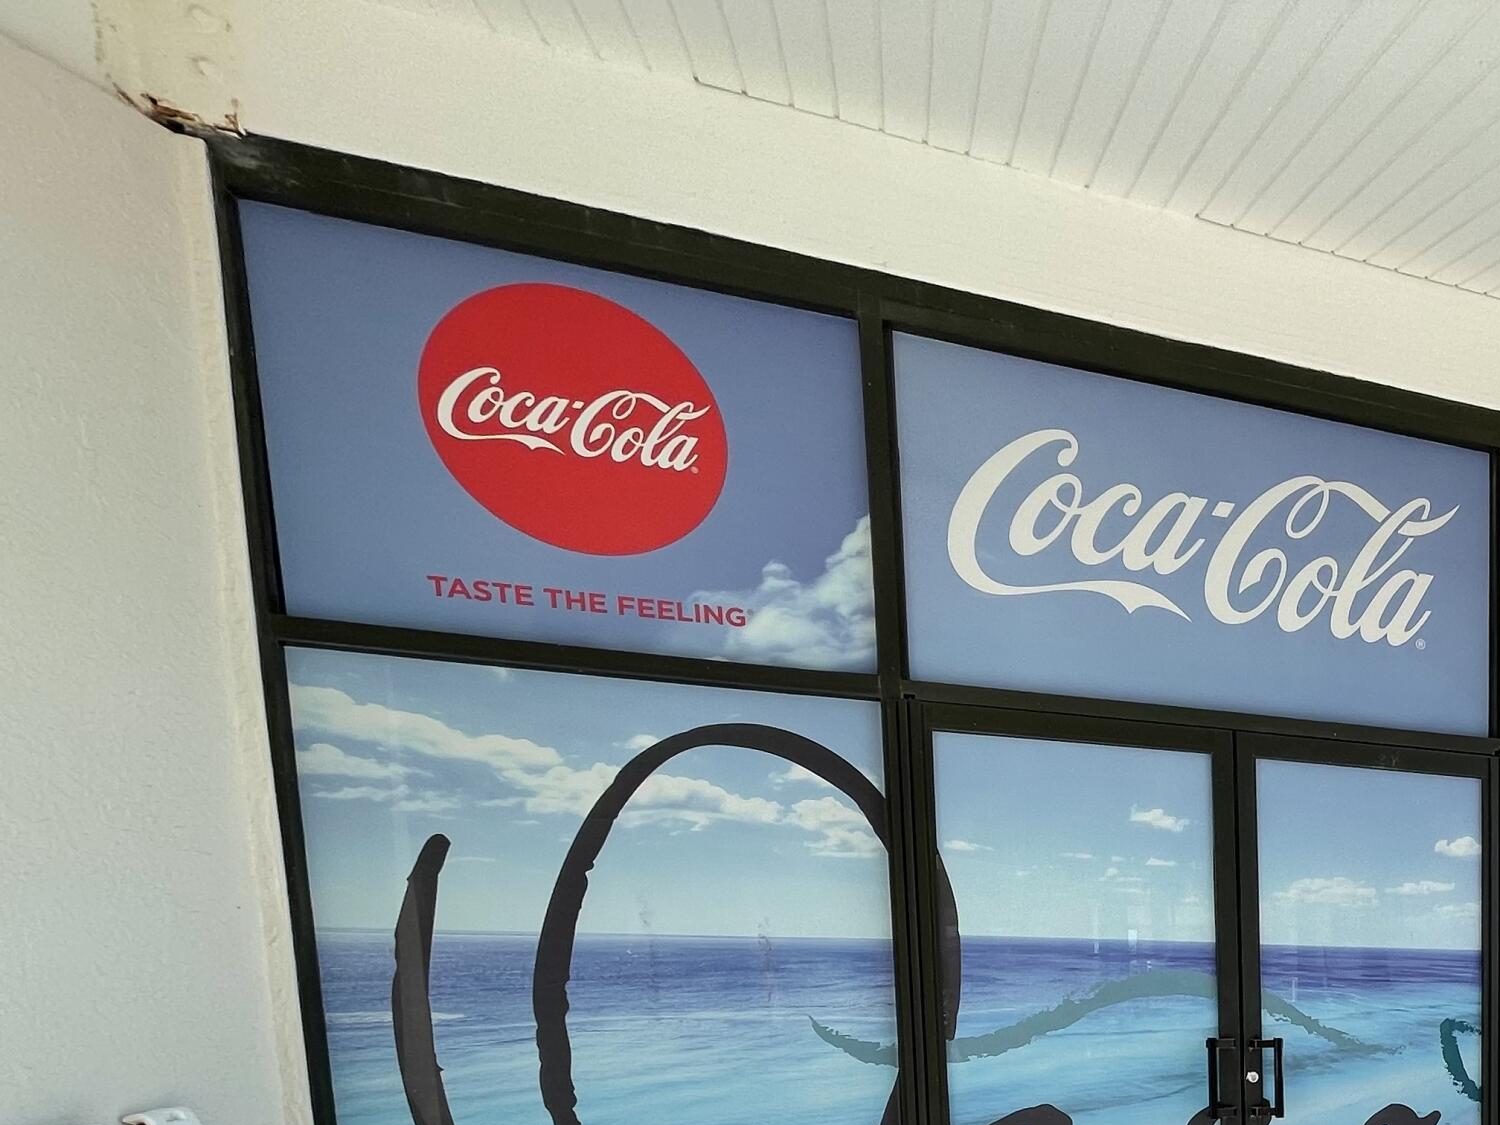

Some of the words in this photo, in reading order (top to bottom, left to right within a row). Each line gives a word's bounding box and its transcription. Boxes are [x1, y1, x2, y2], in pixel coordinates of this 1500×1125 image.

[437, 366, 711, 473] Coca-Cola
[947, 428, 1460, 647] Coca-Cola
[427, 575, 532, 606] TASTE
[543, 588, 608, 614] THE
[617, 596, 747, 627] FEELING
